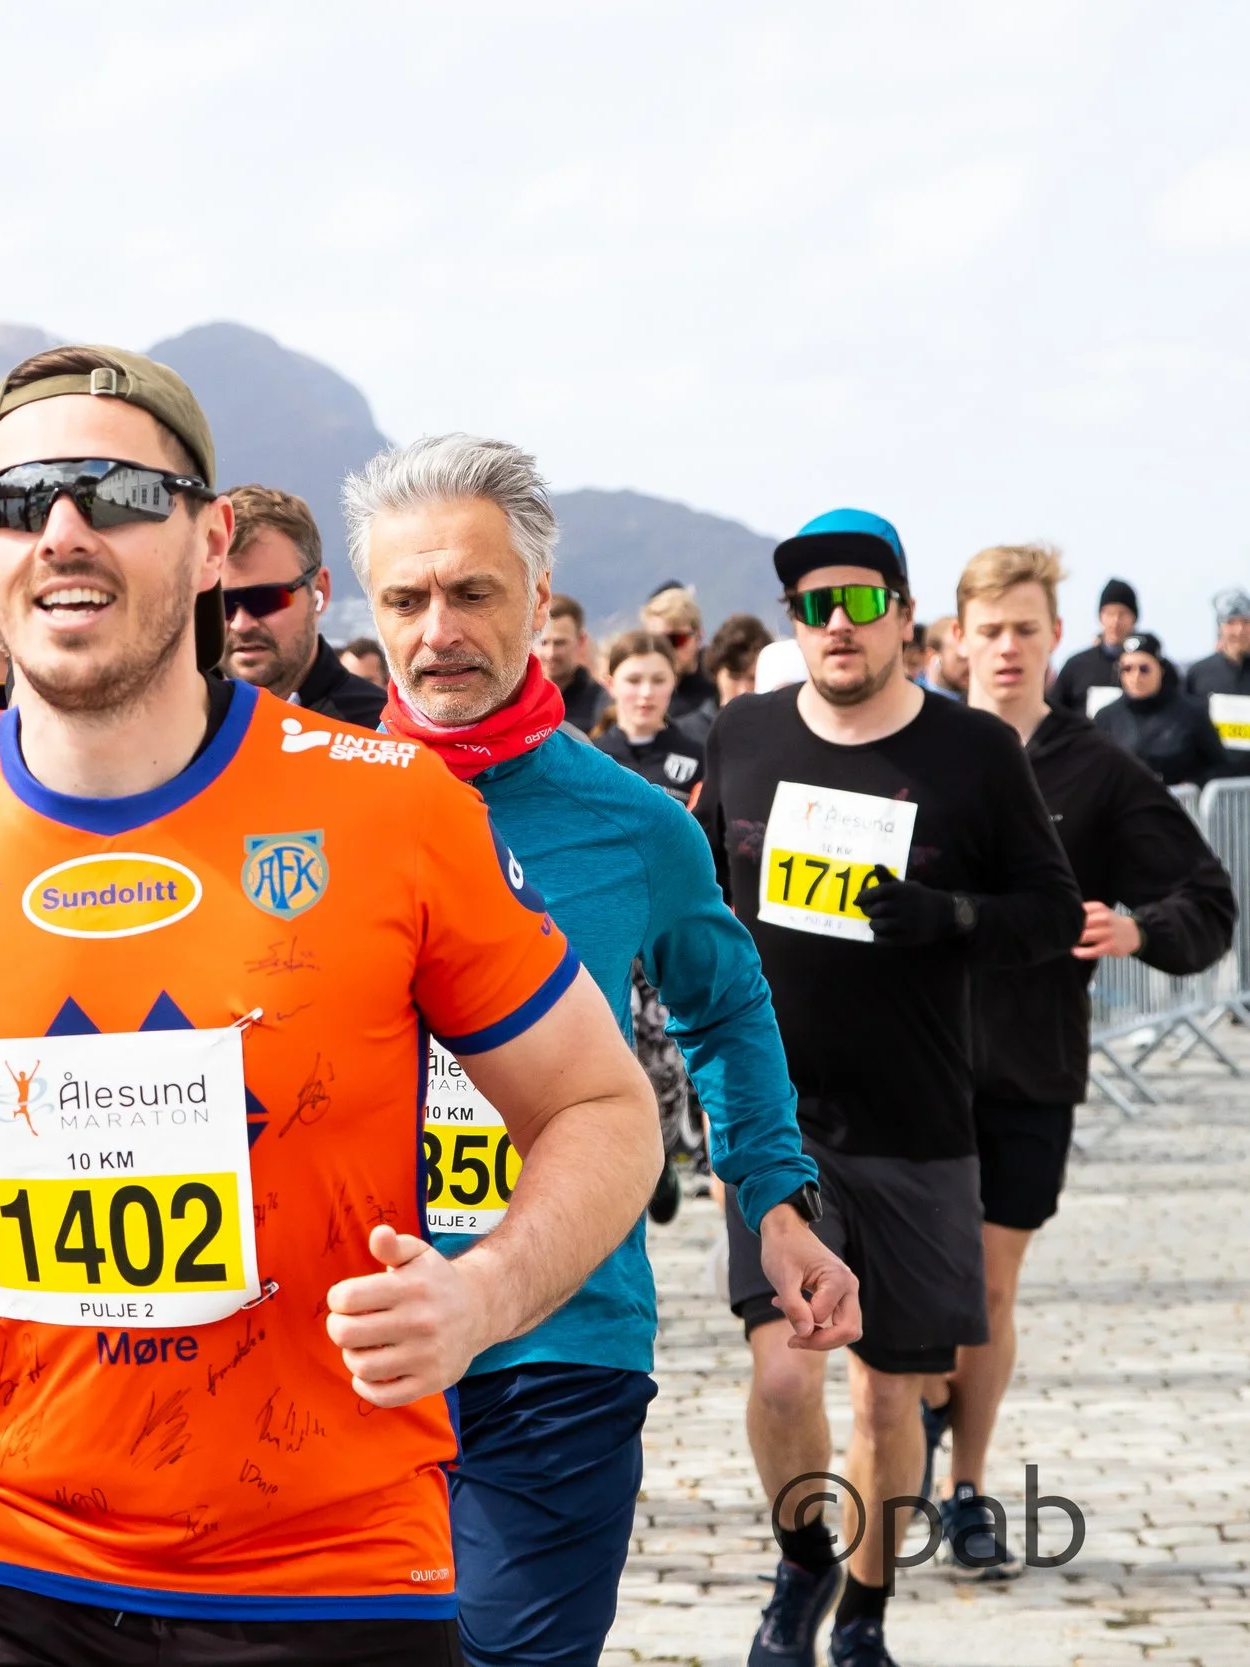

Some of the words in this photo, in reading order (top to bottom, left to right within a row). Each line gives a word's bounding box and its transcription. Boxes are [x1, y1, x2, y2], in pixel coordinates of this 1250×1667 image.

[329, 744, 416, 768] SPORT
[333, 733, 417, 755] INTER
[254, 846, 319, 910] AFK
[41, 876, 179, 910] Sundolitt
[428, 1047, 462, 1077] Åle
[59, 1072, 207, 1111] Ålesund
[60, 1108, 210, 1130] MARATON
[447, 1107, 474, 1121] KM
[66, 1153, 91, 1170] 10
[100, 1151, 134, 1170] KM
[428, 1214, 464, 1227] ULJE
[469, 1216, 477, 1227] 2
[0, 1181, 228, 1287] 1402
[80, 1302, 138, 1318] PULJE
[145, 1303, 154, 1318] 2
[96, 1331, 198, 1366] Møre
